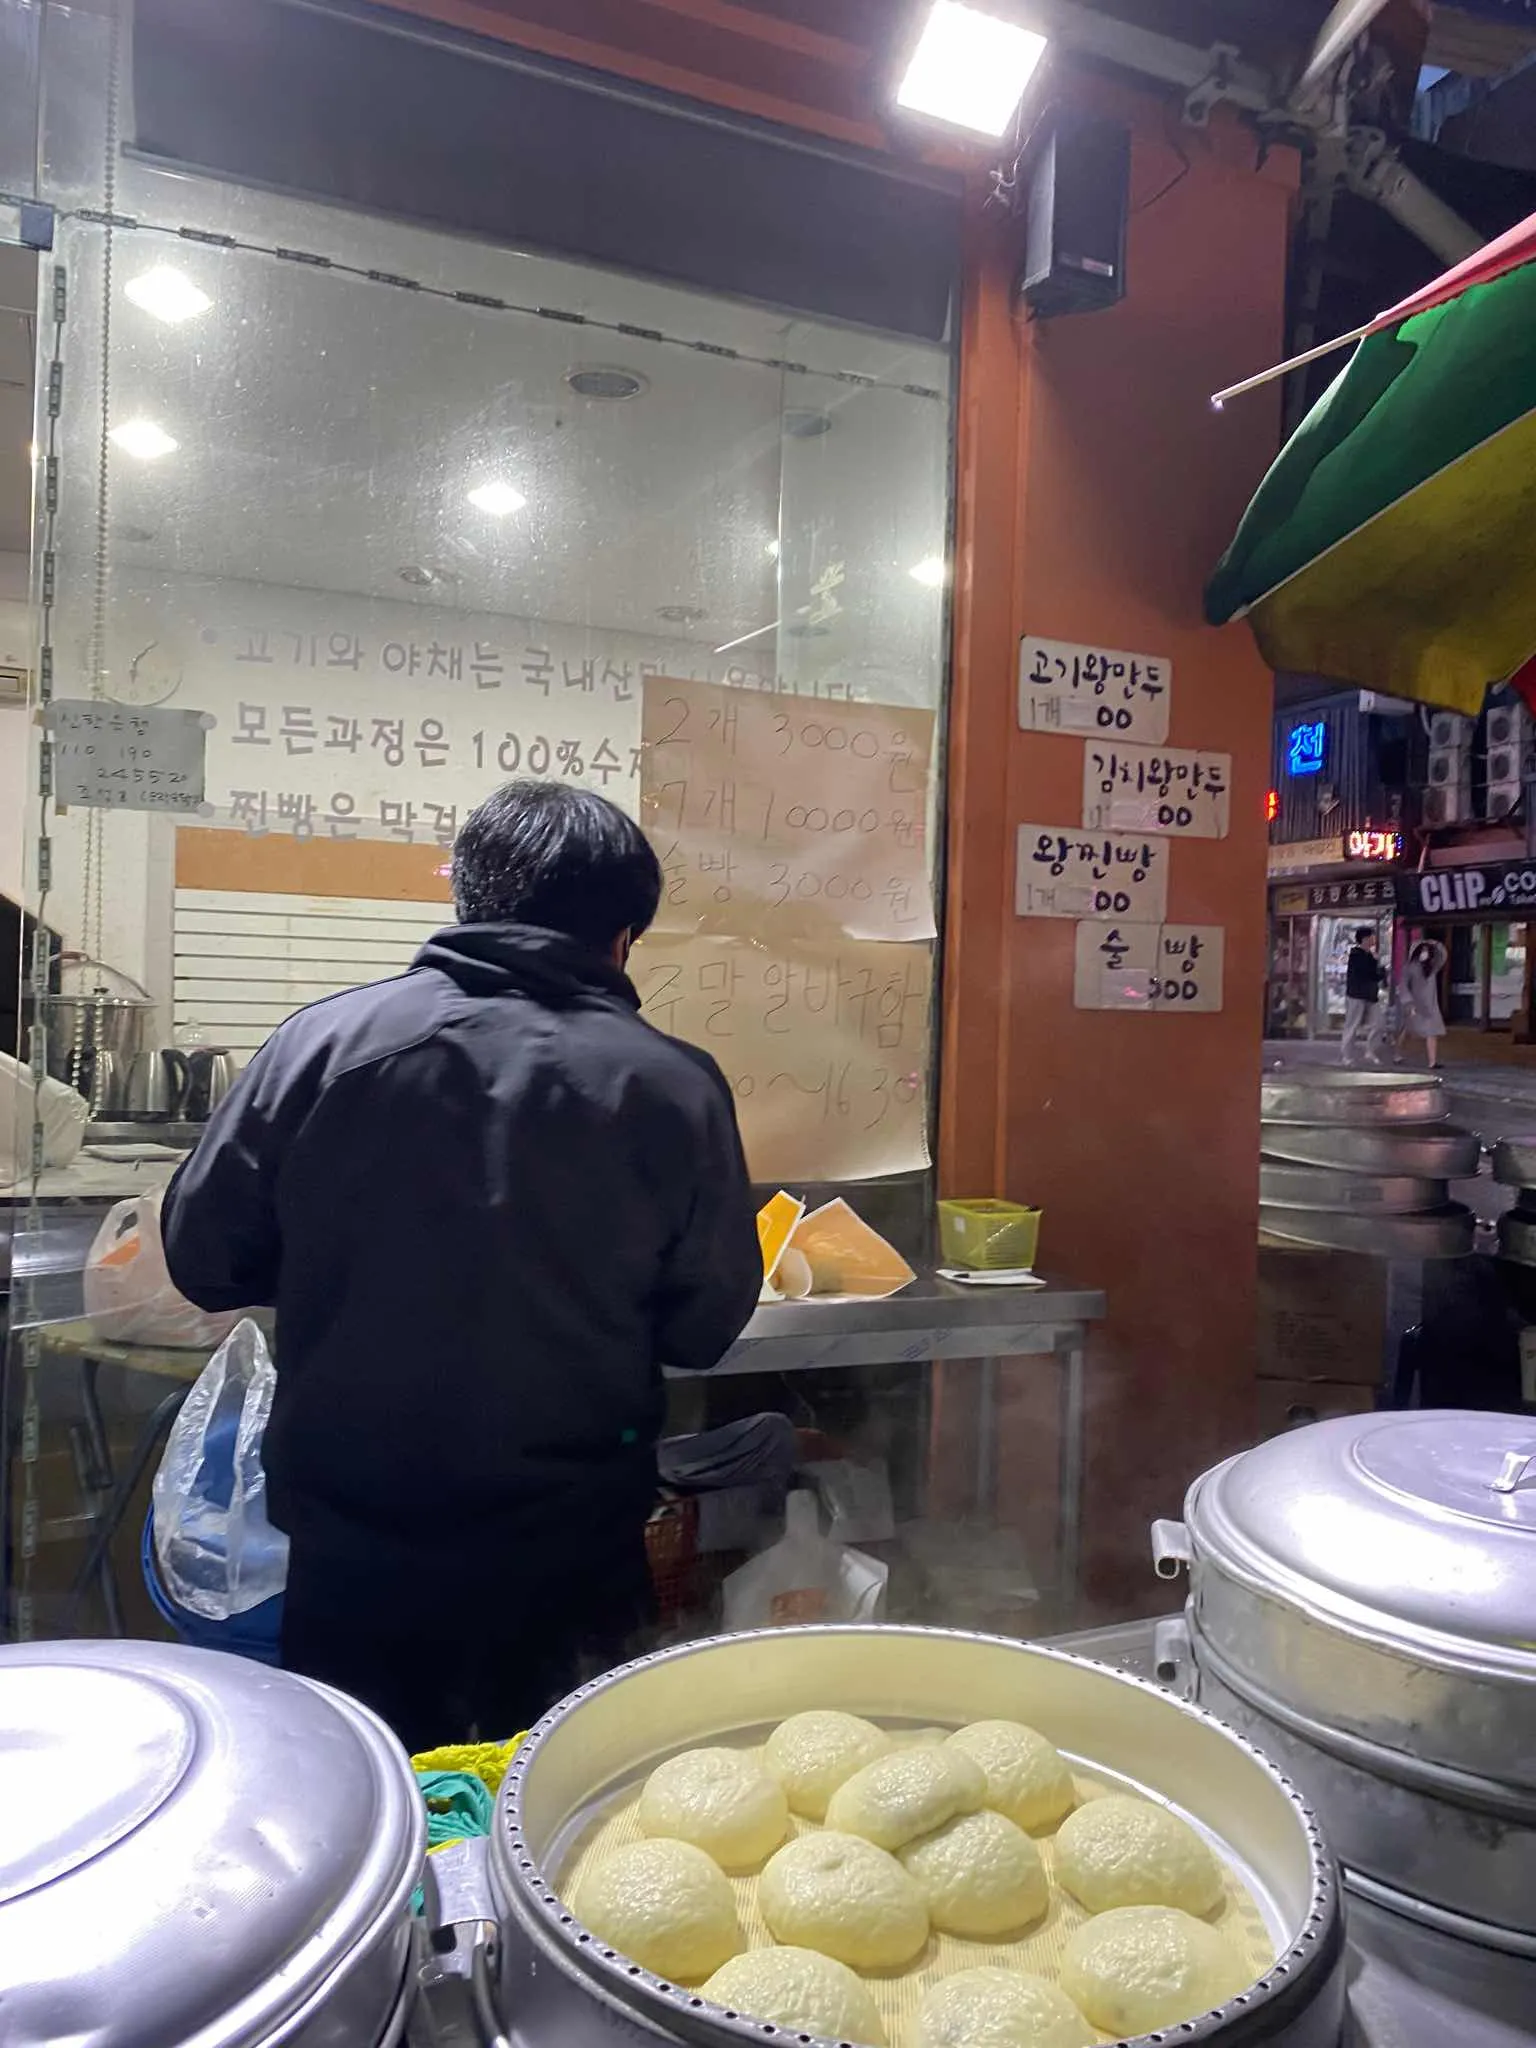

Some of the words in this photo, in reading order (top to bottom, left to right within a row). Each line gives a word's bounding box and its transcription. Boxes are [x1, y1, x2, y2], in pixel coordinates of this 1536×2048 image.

[382, 642, 504, 690] 야채는
[1029, 650, 1163, 701] 고기왕만두
[231, 702, 450, 767] 모든과정은
[655, 696, 738, 757] 2개
[773, 711, 920, 794] 3000원
[1092, 753, 1226, 802] 김치왕만두
[229, 790, 361, 840] 찐빵은
[660, 779, 738, 835] 7개
[763, 790, 918, 850] 10000원
[1032, 834, 1156, 883] 왕찐빵
[769, 861, 918, 924] 3000원
